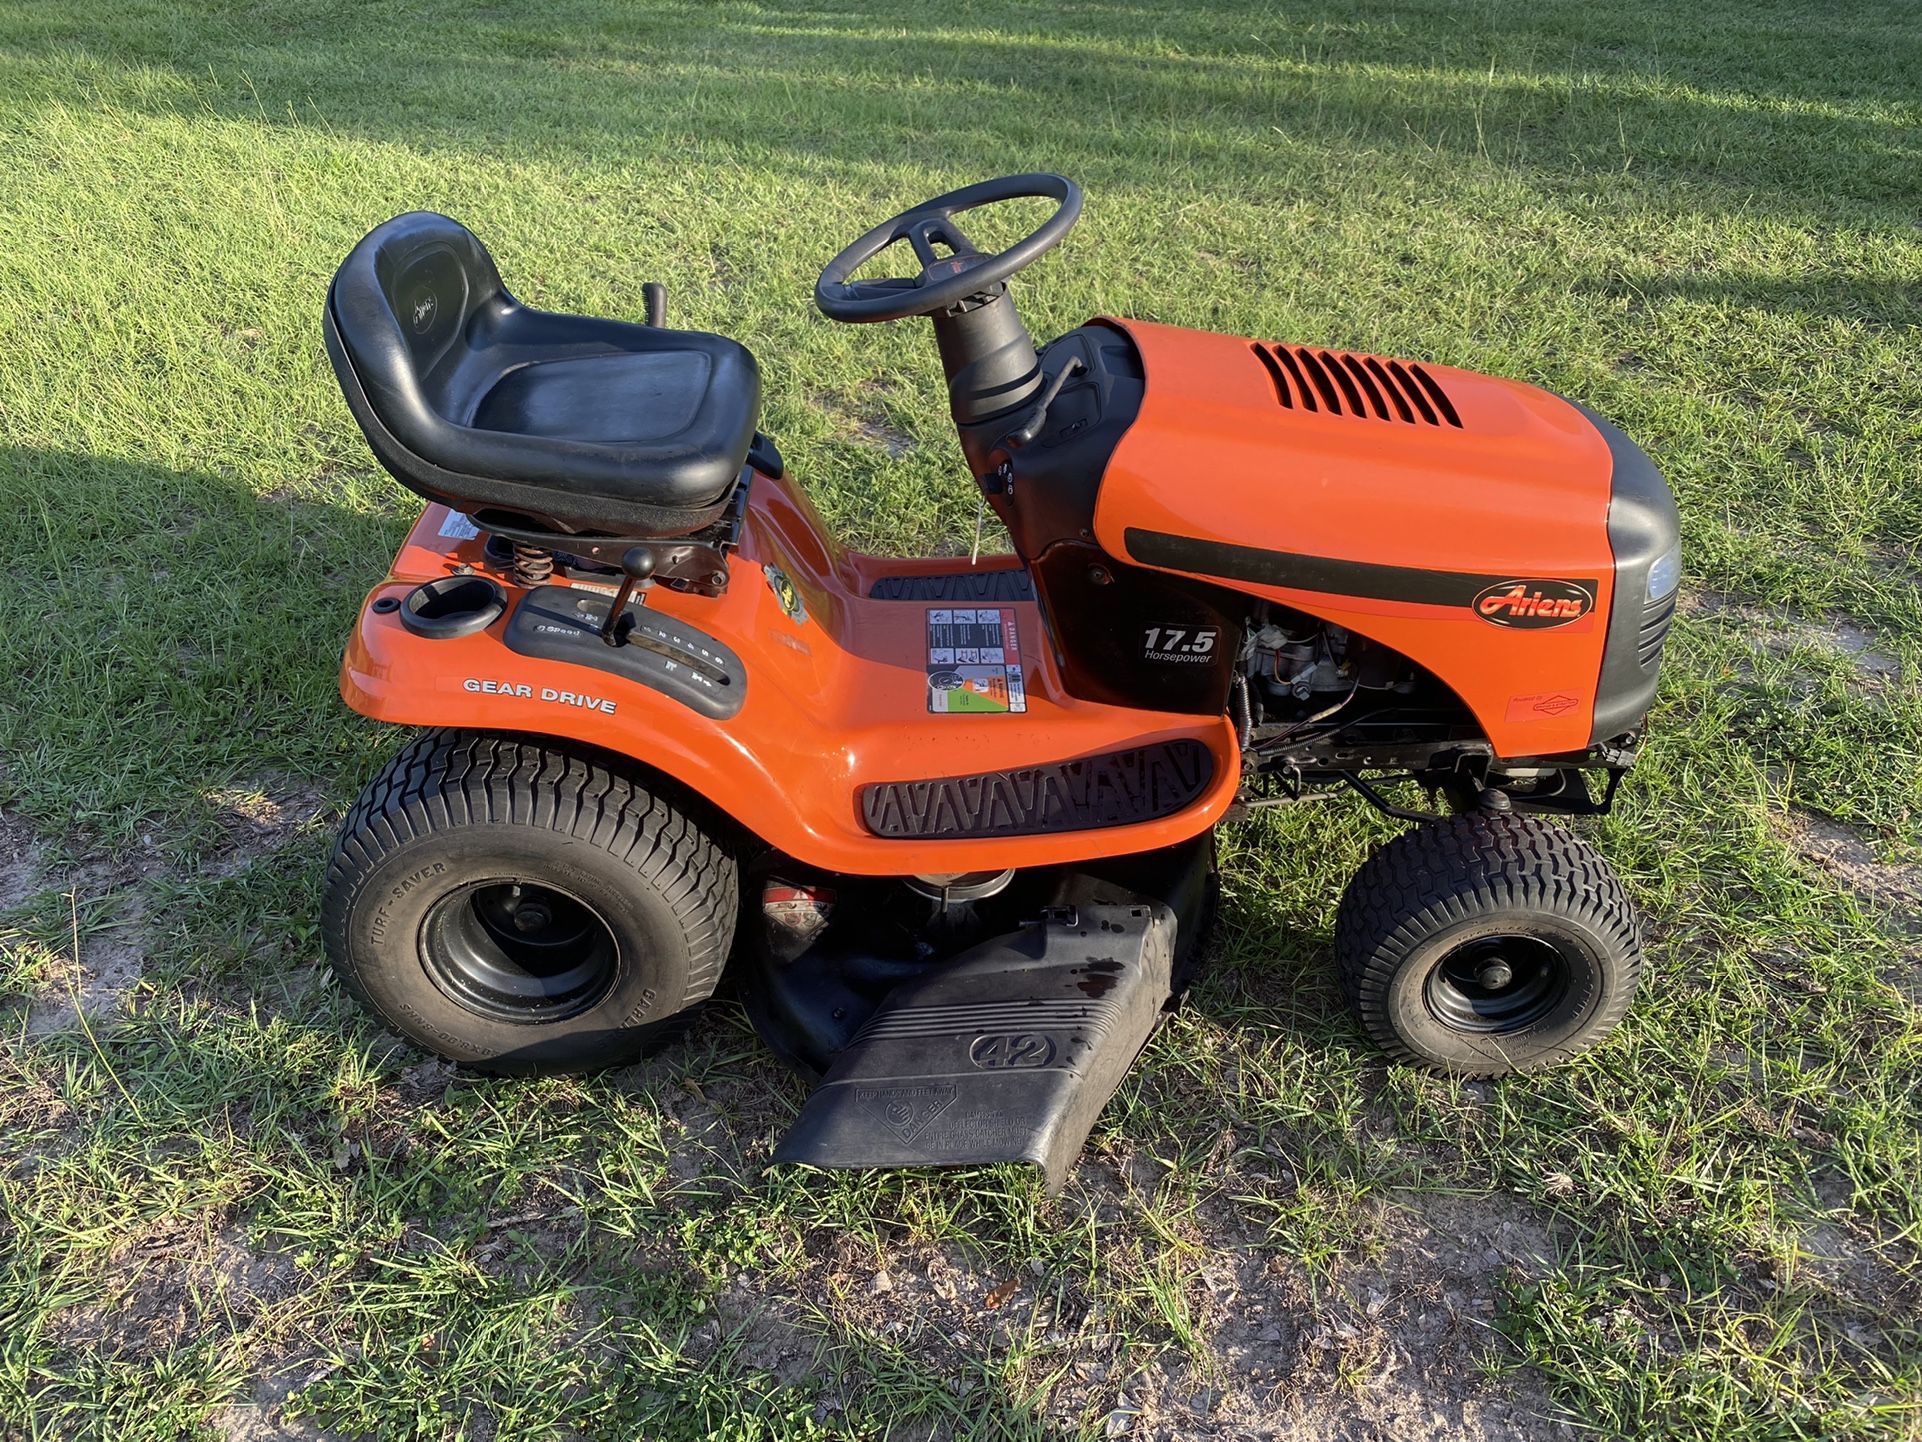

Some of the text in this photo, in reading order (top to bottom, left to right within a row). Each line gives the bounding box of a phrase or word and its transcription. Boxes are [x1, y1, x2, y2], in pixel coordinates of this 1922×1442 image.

[1479, 584, 1583, 618] Ariens
[1144, 627, 1216, 653] 17.5
[1144, 650, 1212, 664] Horsepower
[462, 679, 618, 715] GEAR DRIVE
[975, 1034, 1045, 1067] 42
[899, 1099, 943, 1138] DANGER
